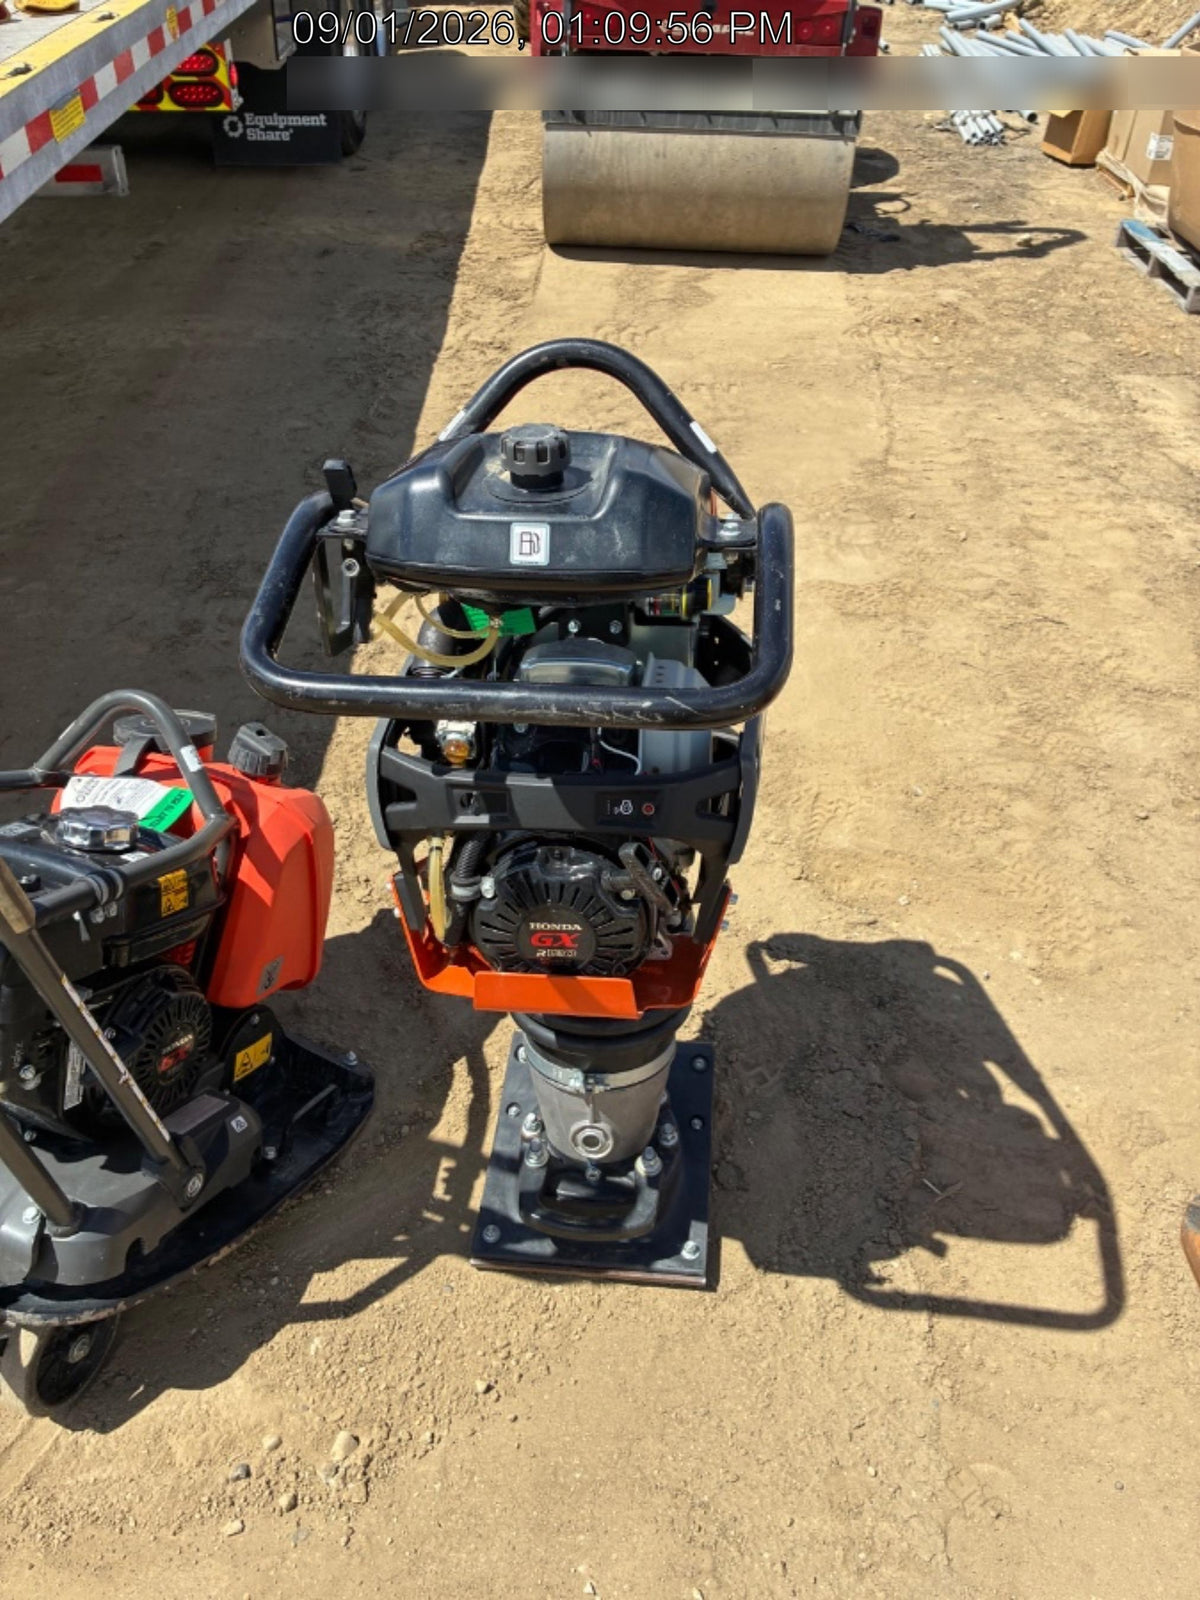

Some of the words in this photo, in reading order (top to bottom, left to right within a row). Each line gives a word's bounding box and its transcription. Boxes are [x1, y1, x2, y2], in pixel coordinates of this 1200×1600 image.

[244, 112, 328, 128] Equipment
[529, 922, 582, 931] HONDA
[530, 932, 581, 948] GX
